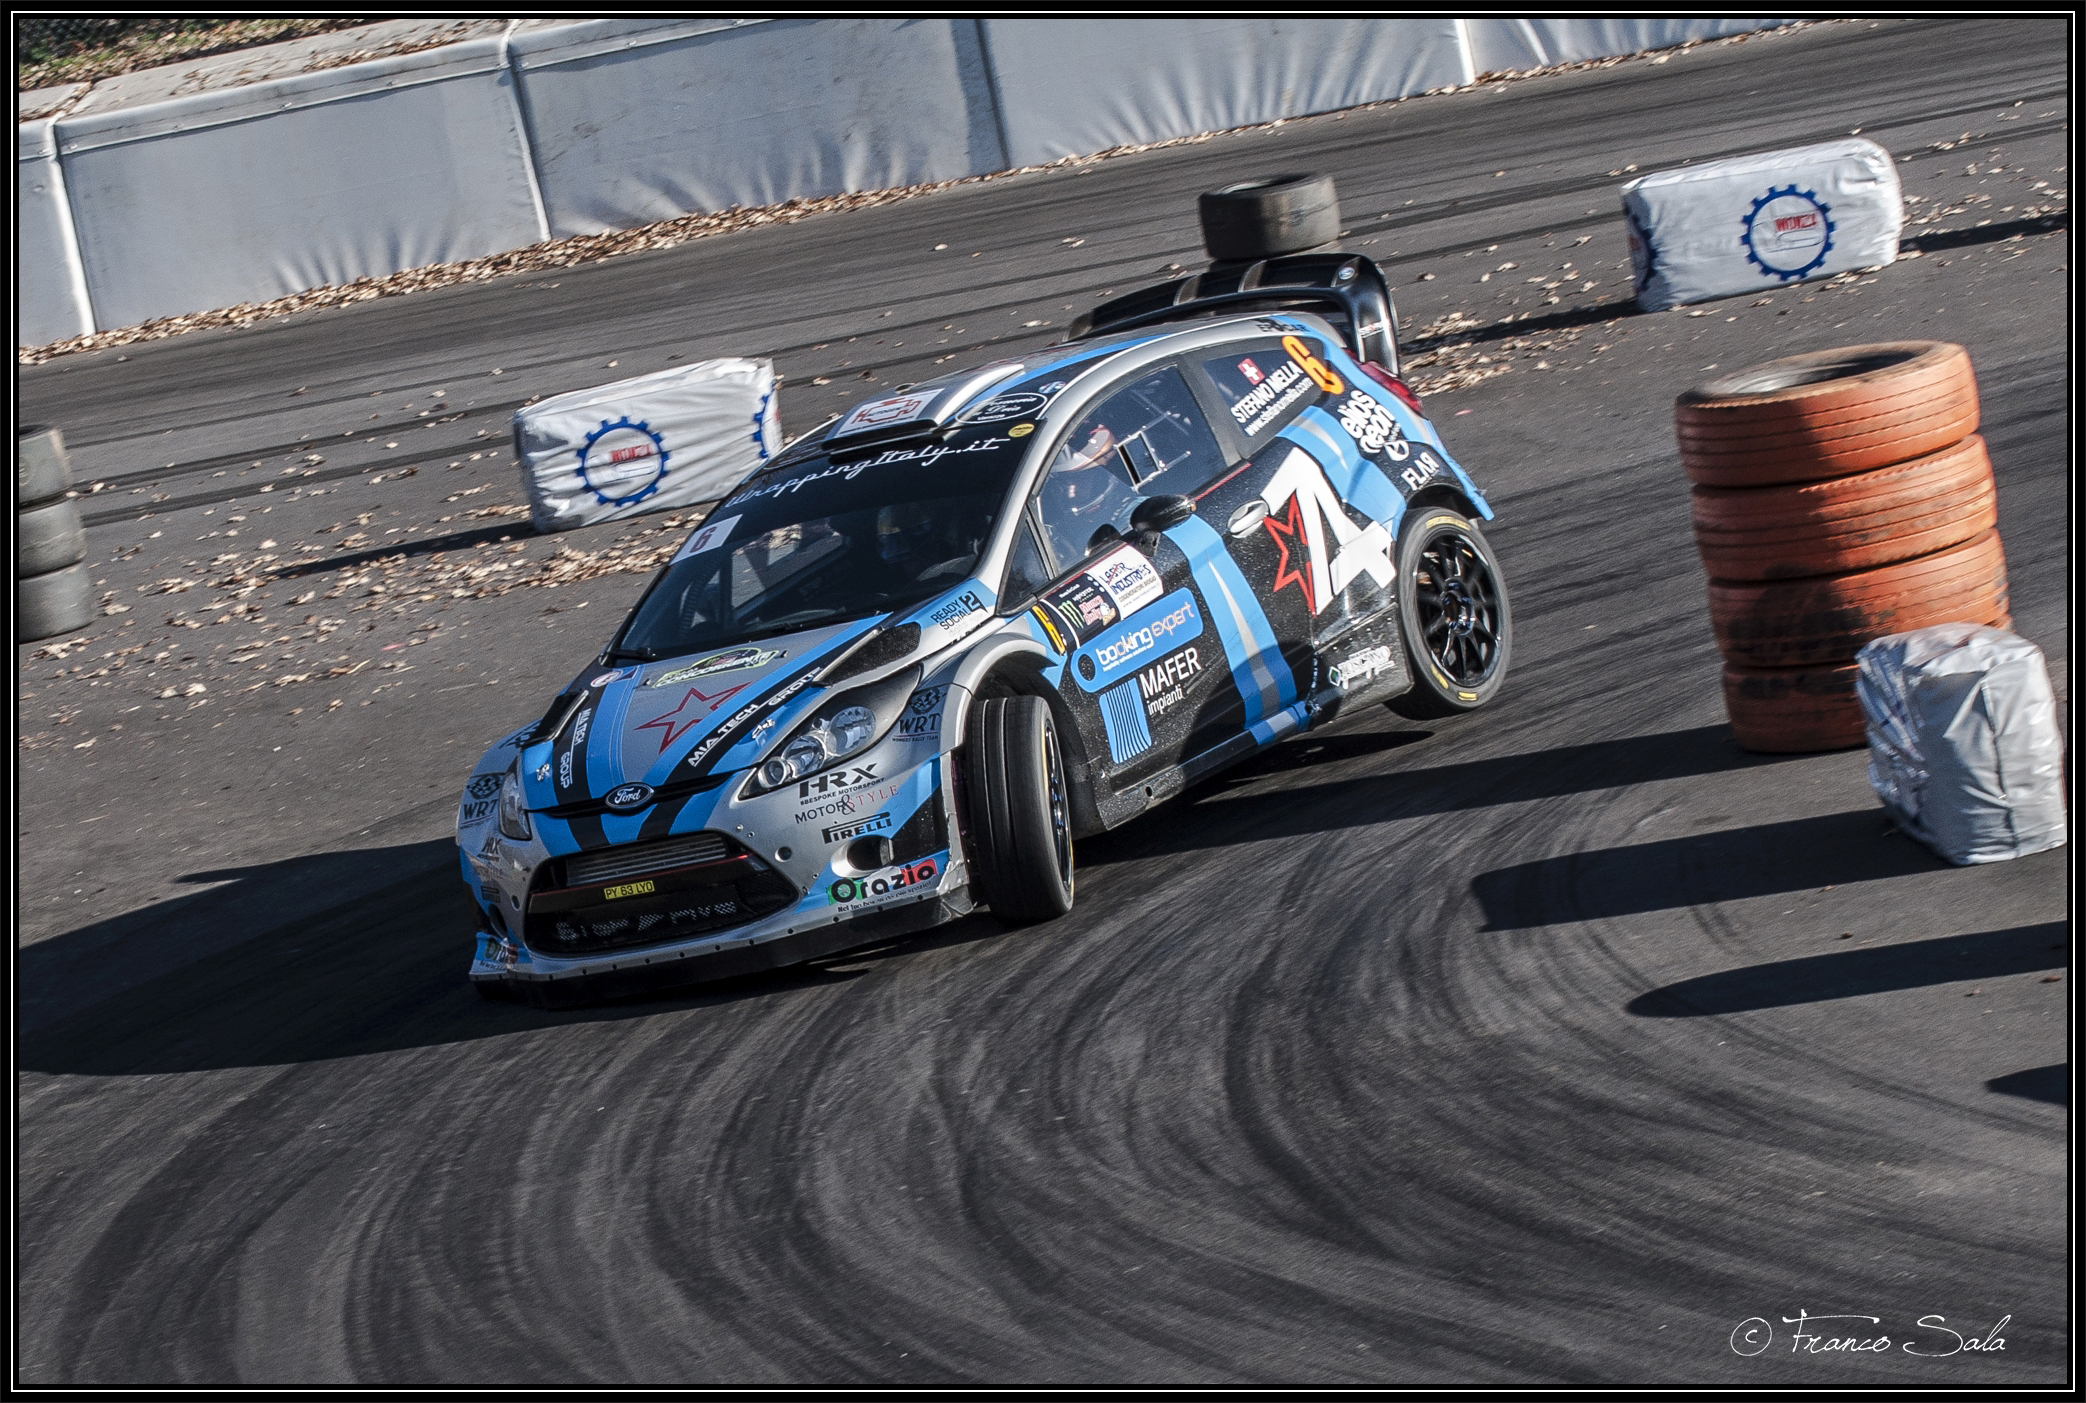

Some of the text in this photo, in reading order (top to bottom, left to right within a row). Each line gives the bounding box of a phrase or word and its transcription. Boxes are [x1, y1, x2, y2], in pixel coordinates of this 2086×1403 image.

[1281, 335, 1346, 395] 6
[1230, 360, 1305, 424] STEFANO MELLA
[1337, 389, 1377, 439] elios
[693, 525, 718, 553] 6
[930, 599, 962, 624] READY
[939, 607, 972, 631] SOCIAL
[1095, 627, 1155, 666] booking
[1151, 601, 1195, 637] expert
[1139, 647, 1201, 699] MAFER
[1147, 684, 1184, 716] impianti
[573, 724, 585, 746] TECH
[687, 737, 720, 768] MIA
[717, 703, 761, 735] TECH
[900, 712, 942, 735] WRT
[560, 751, 571, 789] GROUP
[799, 763, 878, 799] HRX
[838, 777, 885, 796] MOTORSPORT
[614, 787, 641, 805] Ford
[821, 811, 892, 844] PIRELLI
[606, 887, 619, 899] PY
[620, 885, 634, 896] 63
[831, 864, 935, 904] Orazio
